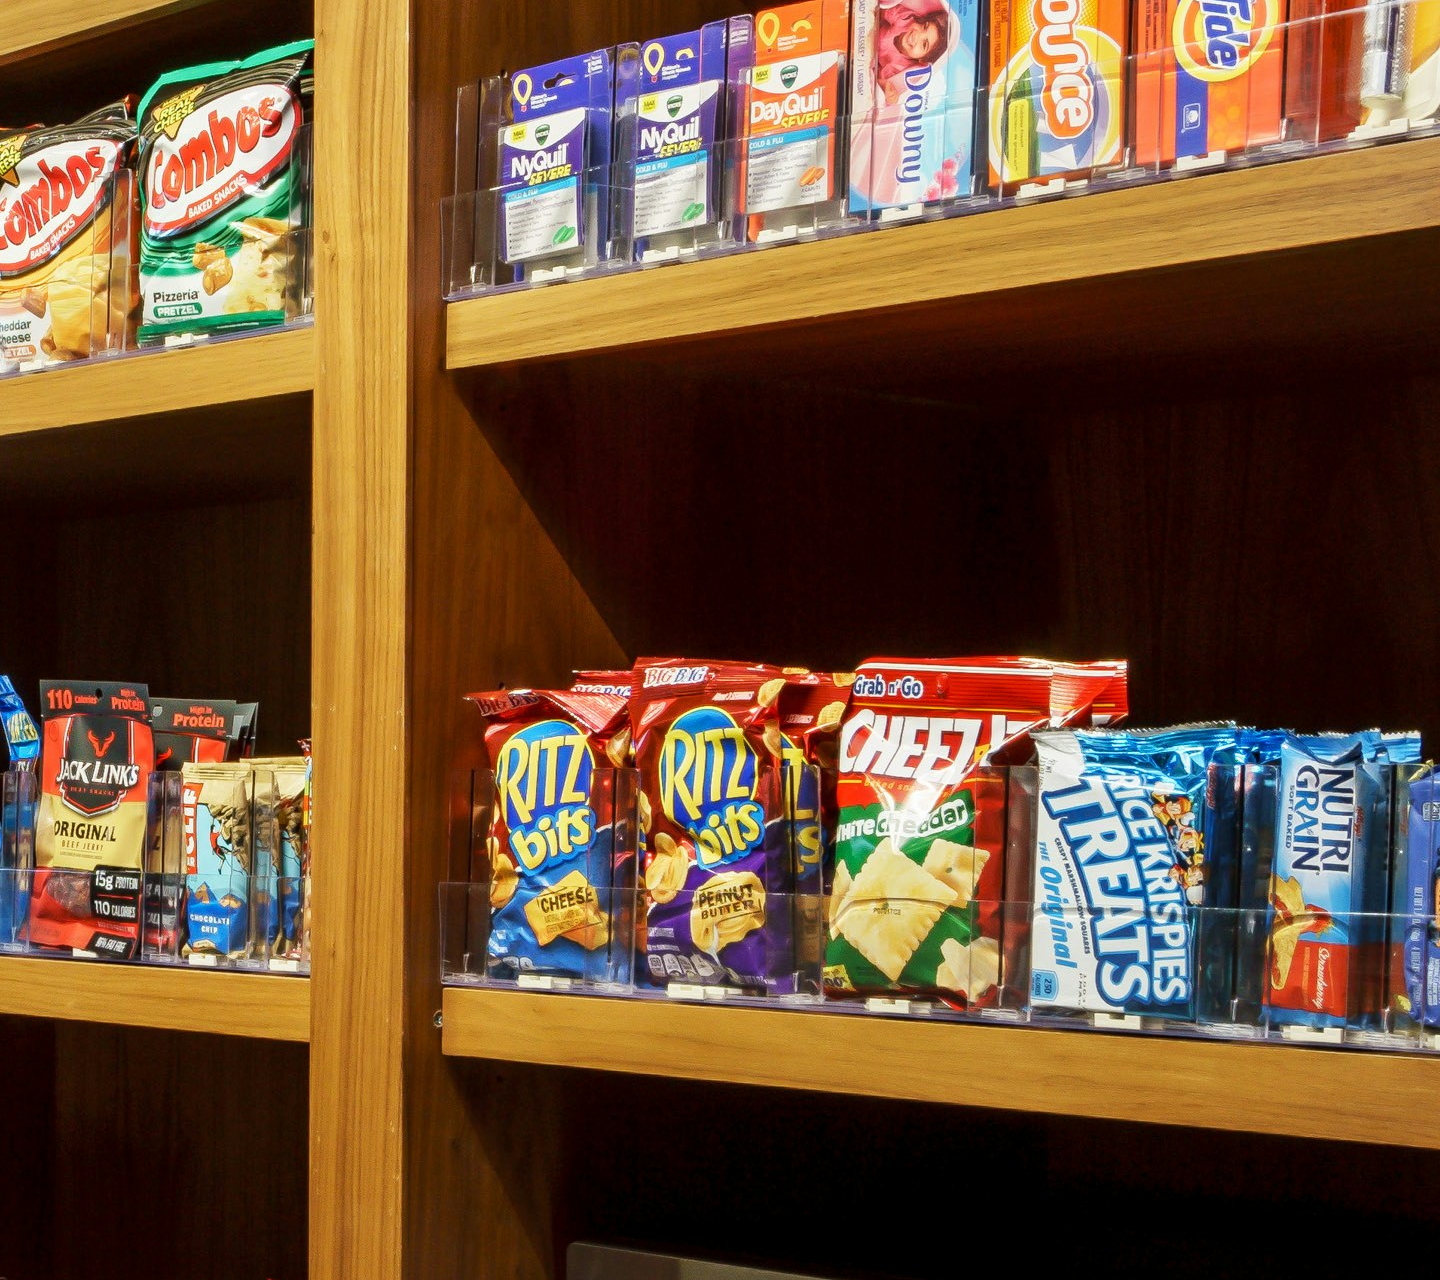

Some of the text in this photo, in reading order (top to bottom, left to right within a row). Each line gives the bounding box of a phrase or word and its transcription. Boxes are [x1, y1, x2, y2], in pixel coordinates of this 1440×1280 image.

[751, 87, 823, 125] DayQuil
[640, 117, 700, 153] NyQuil
[896, 64, 932, 184] Downy
[151, 97, 282, 208] Combos
[511, 143, 568, 180] NyQuil
[529, 164, 572, 186] SEVERE
[188, 173, 247, 218] BAKED SNACKS
[29, 218, 76, 260] BAKED SNACKS
[153, 290, 199, 303] Pizzeria
[157, 305, 199, 317] PRETZEL
[644, 667, 709, 687] BIG BAG
[854, 675, 923, 697] Grab Go
[47, 689, 73, 710] 110
[110, 697, 146, 712] Protein
[173, 713, 225, 728] Protein
[57, 758, 139, 787] JACK LINK'S
[502, 734, 591, 824] RITZ
[665, 728, 750, 820] RITZ
[54, 820, 117, 841] ORIGINAL
[1291, 764, 1320, 873] GRAIN
[1320, 768, 1356, 873] NUTRI
[511, 807, 590, 870] bits
[96, 871, 138, 889] 15g PROTEIN
[698, 884, 753, 907] PEANUT
[1041, 778, 1151, 1003] TREATS
[1111, 772, 1187, 1000] RICE KRISPIES
[95, 899, 110, 915] 110
[540, 886, 594, 913] CHEESE
[701, 899, 754, 919] BUTTER
[1040, 866, 1078, 969] Original
